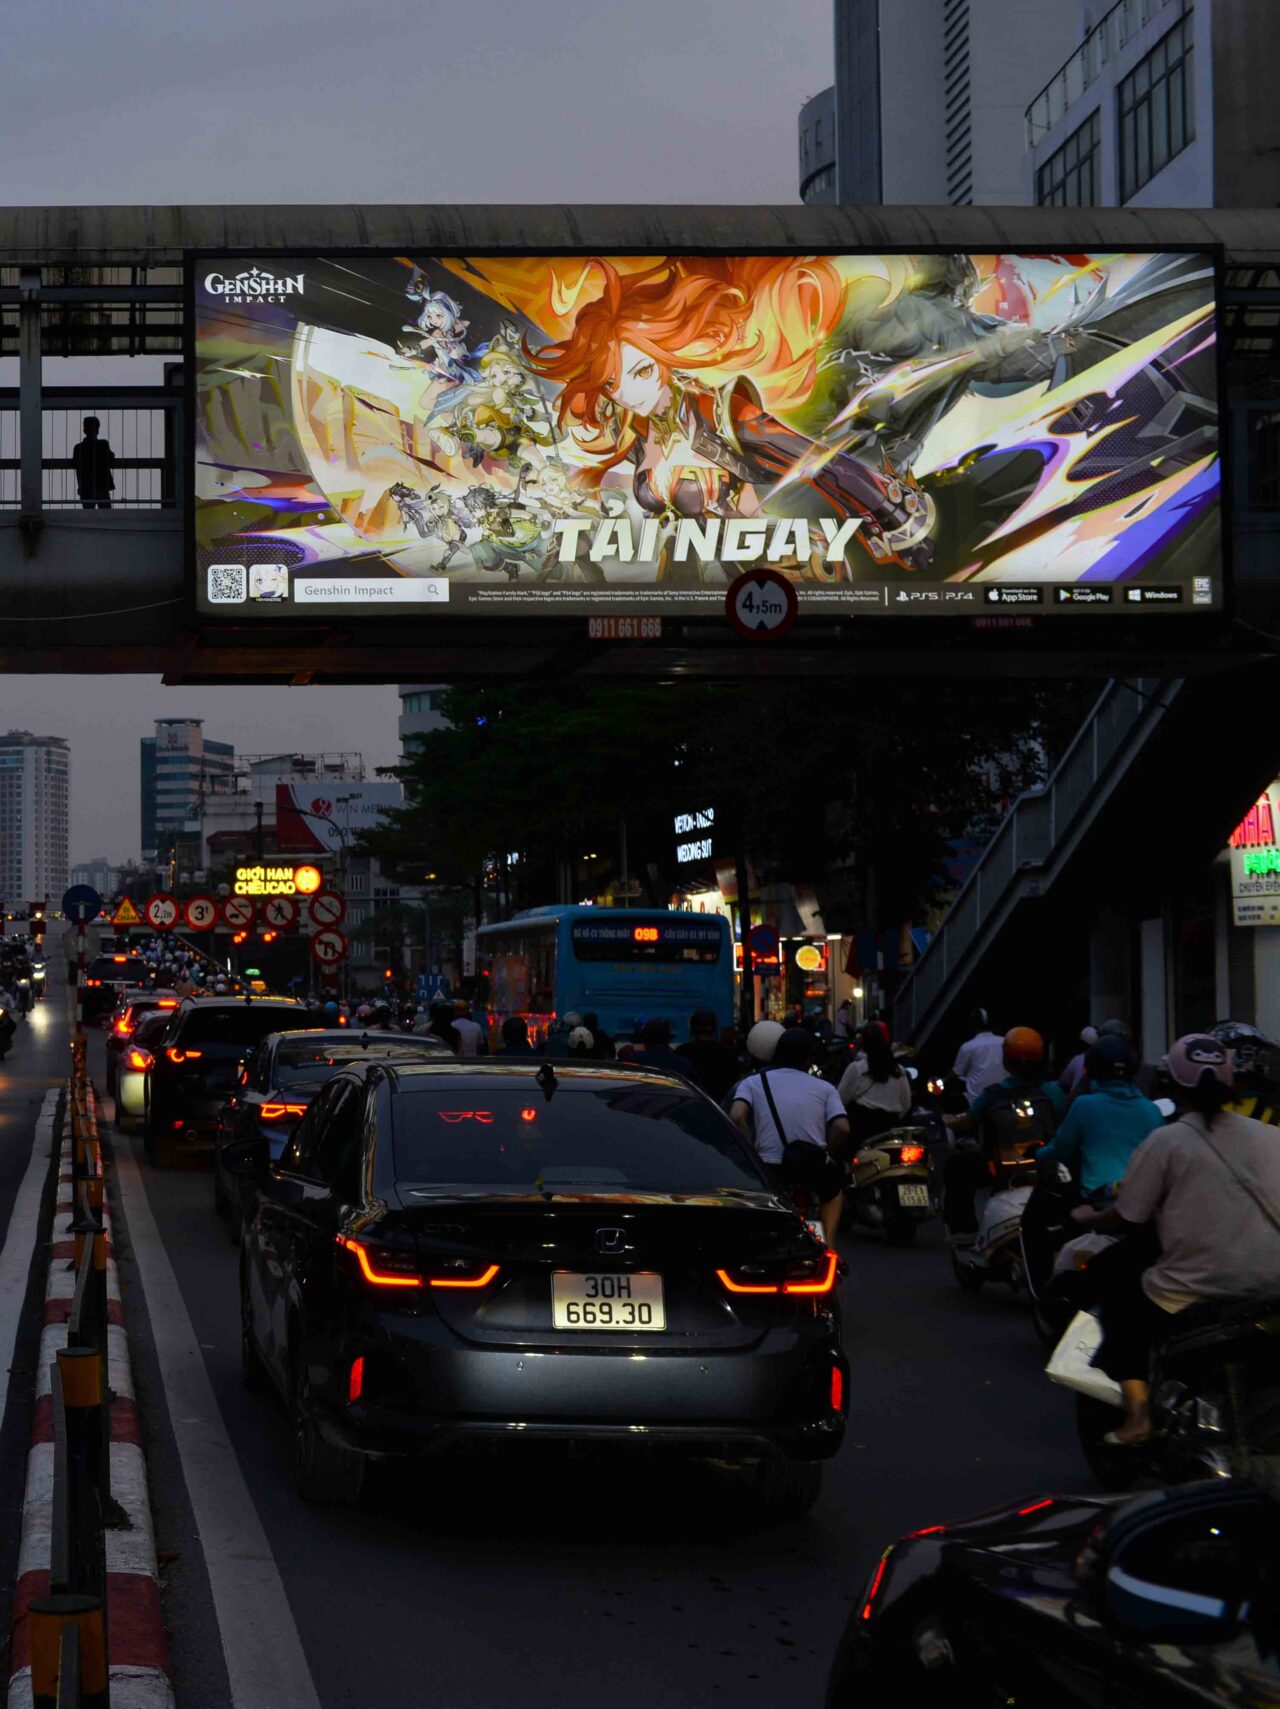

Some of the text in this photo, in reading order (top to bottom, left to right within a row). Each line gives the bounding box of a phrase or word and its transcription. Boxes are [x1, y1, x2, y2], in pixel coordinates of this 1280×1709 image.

[204, 272, 305, 295] GENSHIN
[225, 295, 287, 303] IMPACT
[553, 498, 863, 562] TẢI NGAY
[304, 585, 394, 597] Genshin Impact
[910, 592, 975, 600] PS5 PS4
[1001, 593, 1038, 602] App Store
[1072, 593, 1109, 602] Google Play
[1144, 591, 1177, 599] Windows
[742, 591, 782, 615] 4,5m
[589, 618, 661, 638] 0911 661 666
[335, 804, 357, 813] WIN
[634, 927, 658, 941] 09B
[585, 1276, 631, 1299] 30H
[566, 1301, 652, 1325] 669.30
